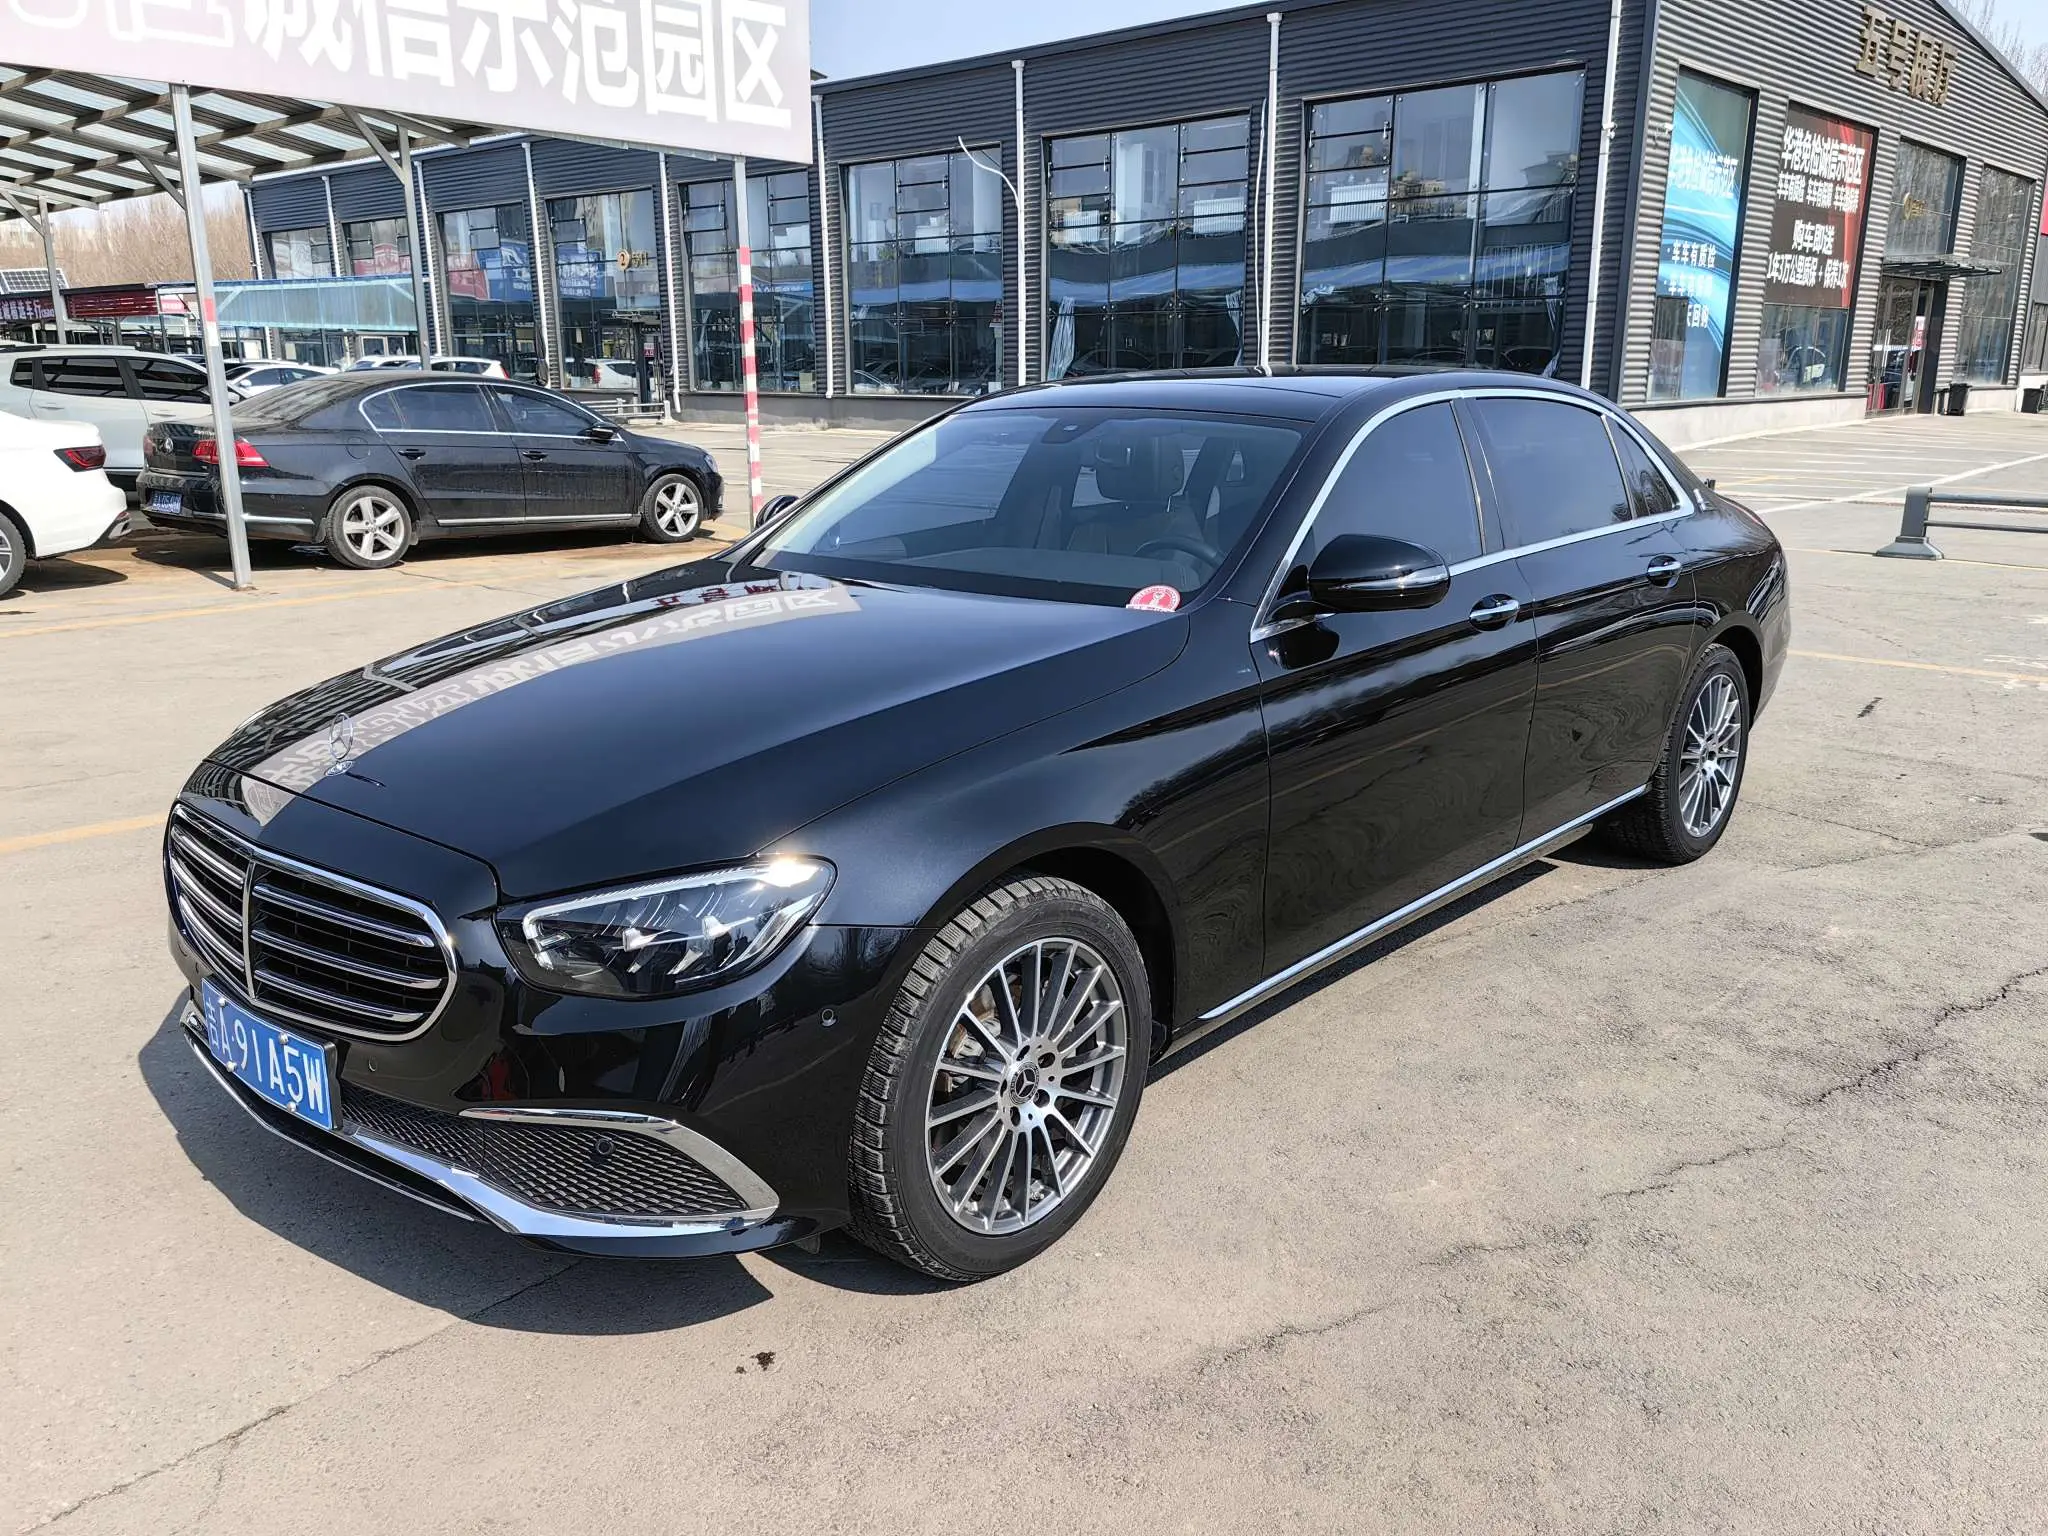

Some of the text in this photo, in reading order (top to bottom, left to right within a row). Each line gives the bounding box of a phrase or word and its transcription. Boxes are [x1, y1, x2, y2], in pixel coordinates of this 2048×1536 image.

[10, 0, 792, 129] 诚信示范园区
[1856, 5, 1959, 107] 五号展厅
[1781, 125, 1865, 185] 华港免检诚信示范区
[1671, 239, 1716, 268] 车车有质检
[1792, 219, 1835, 255] 购车即送
